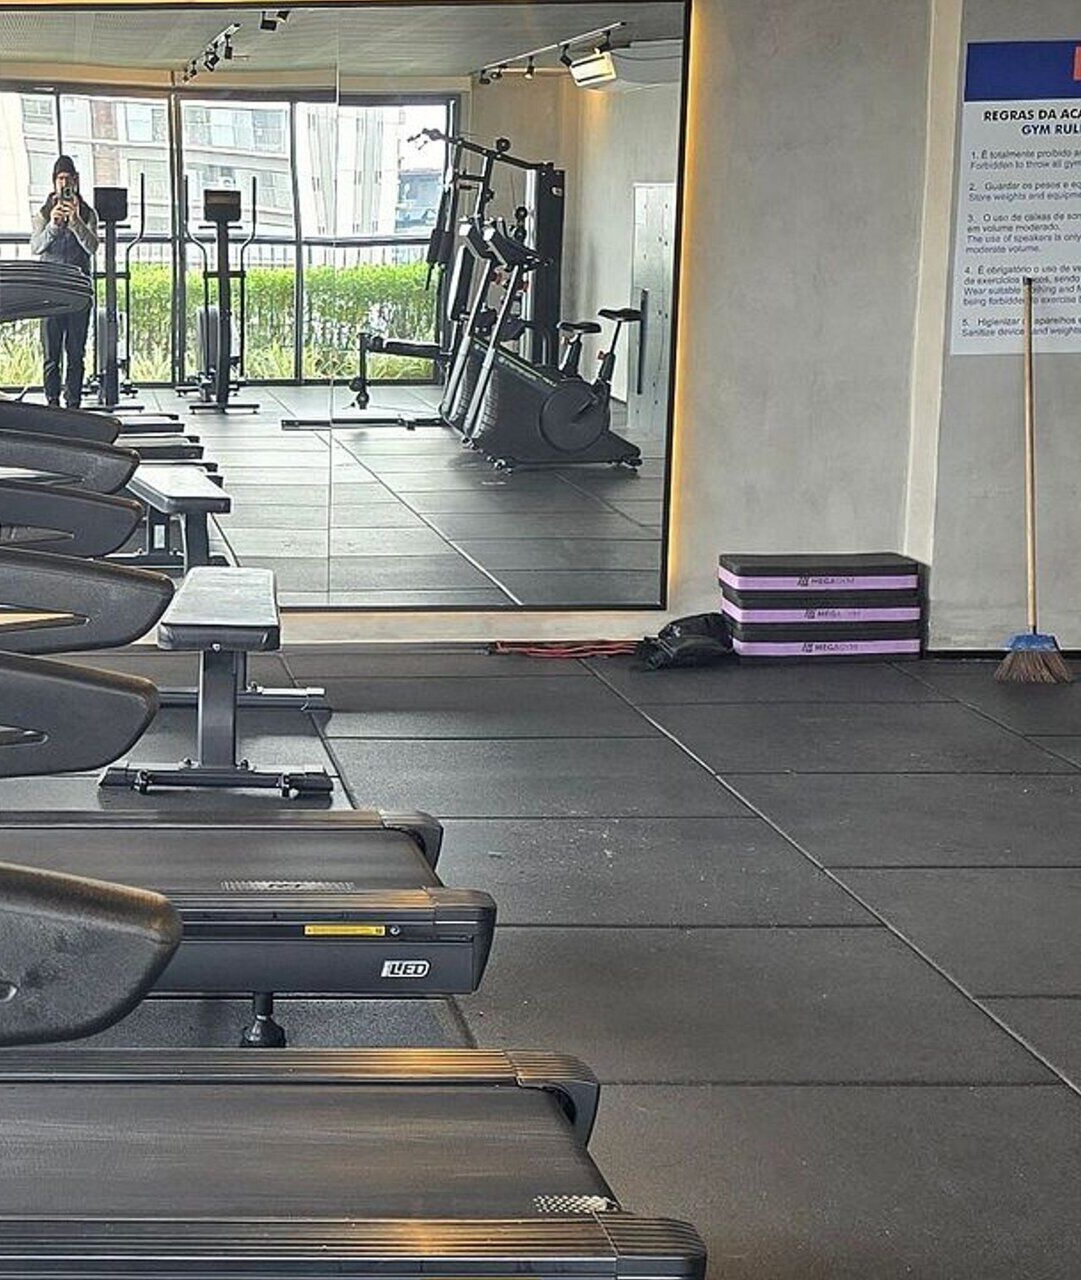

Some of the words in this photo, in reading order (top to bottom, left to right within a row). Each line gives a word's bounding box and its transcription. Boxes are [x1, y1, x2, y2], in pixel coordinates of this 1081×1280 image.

[983, 110, 1034, 122] REGRAS
[1038, 109, 1057, 120] DA
[1021, 124, 1050, 135] GYM
[1054, 123, 1081, 134] RUL
